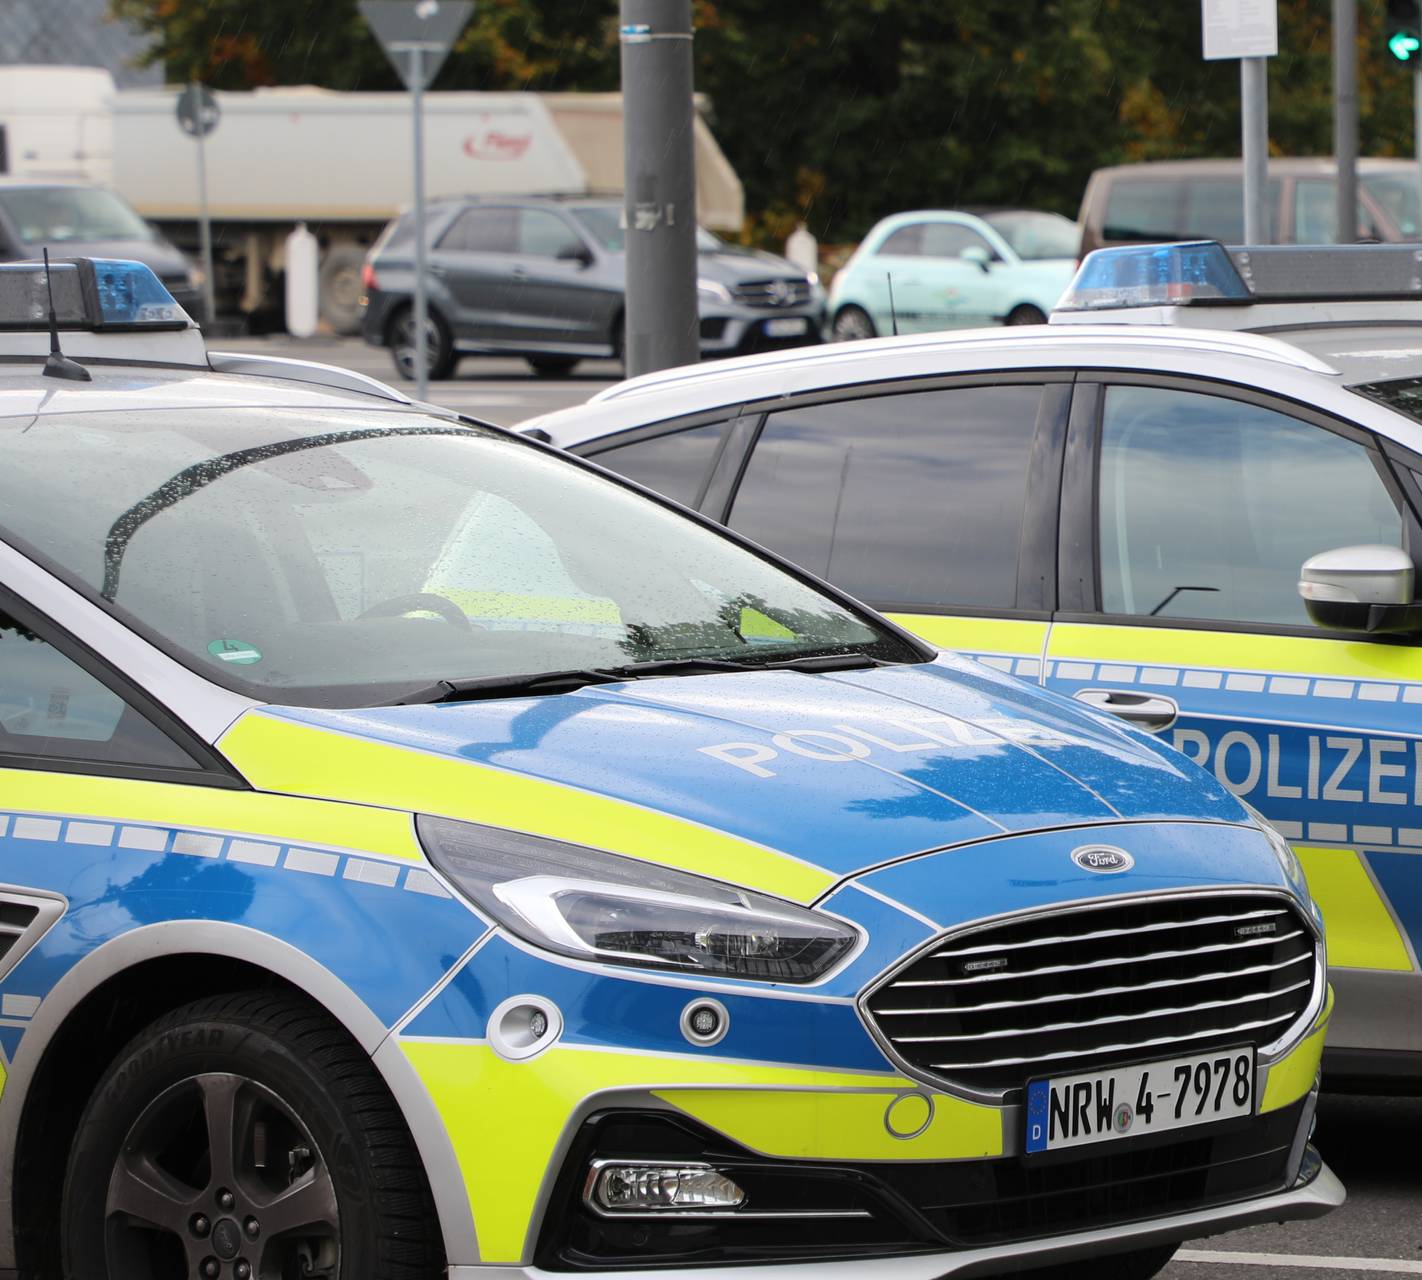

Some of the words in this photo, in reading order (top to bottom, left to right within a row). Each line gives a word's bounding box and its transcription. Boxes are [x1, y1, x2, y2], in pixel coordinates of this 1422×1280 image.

[1088, 853, 1119, 867] Ford
[1049, 1077, 1116, 1141] NRW
[1136, 1055, 1250, 1124] 4-7978
[1032, 1125, 1041, 1140] D
